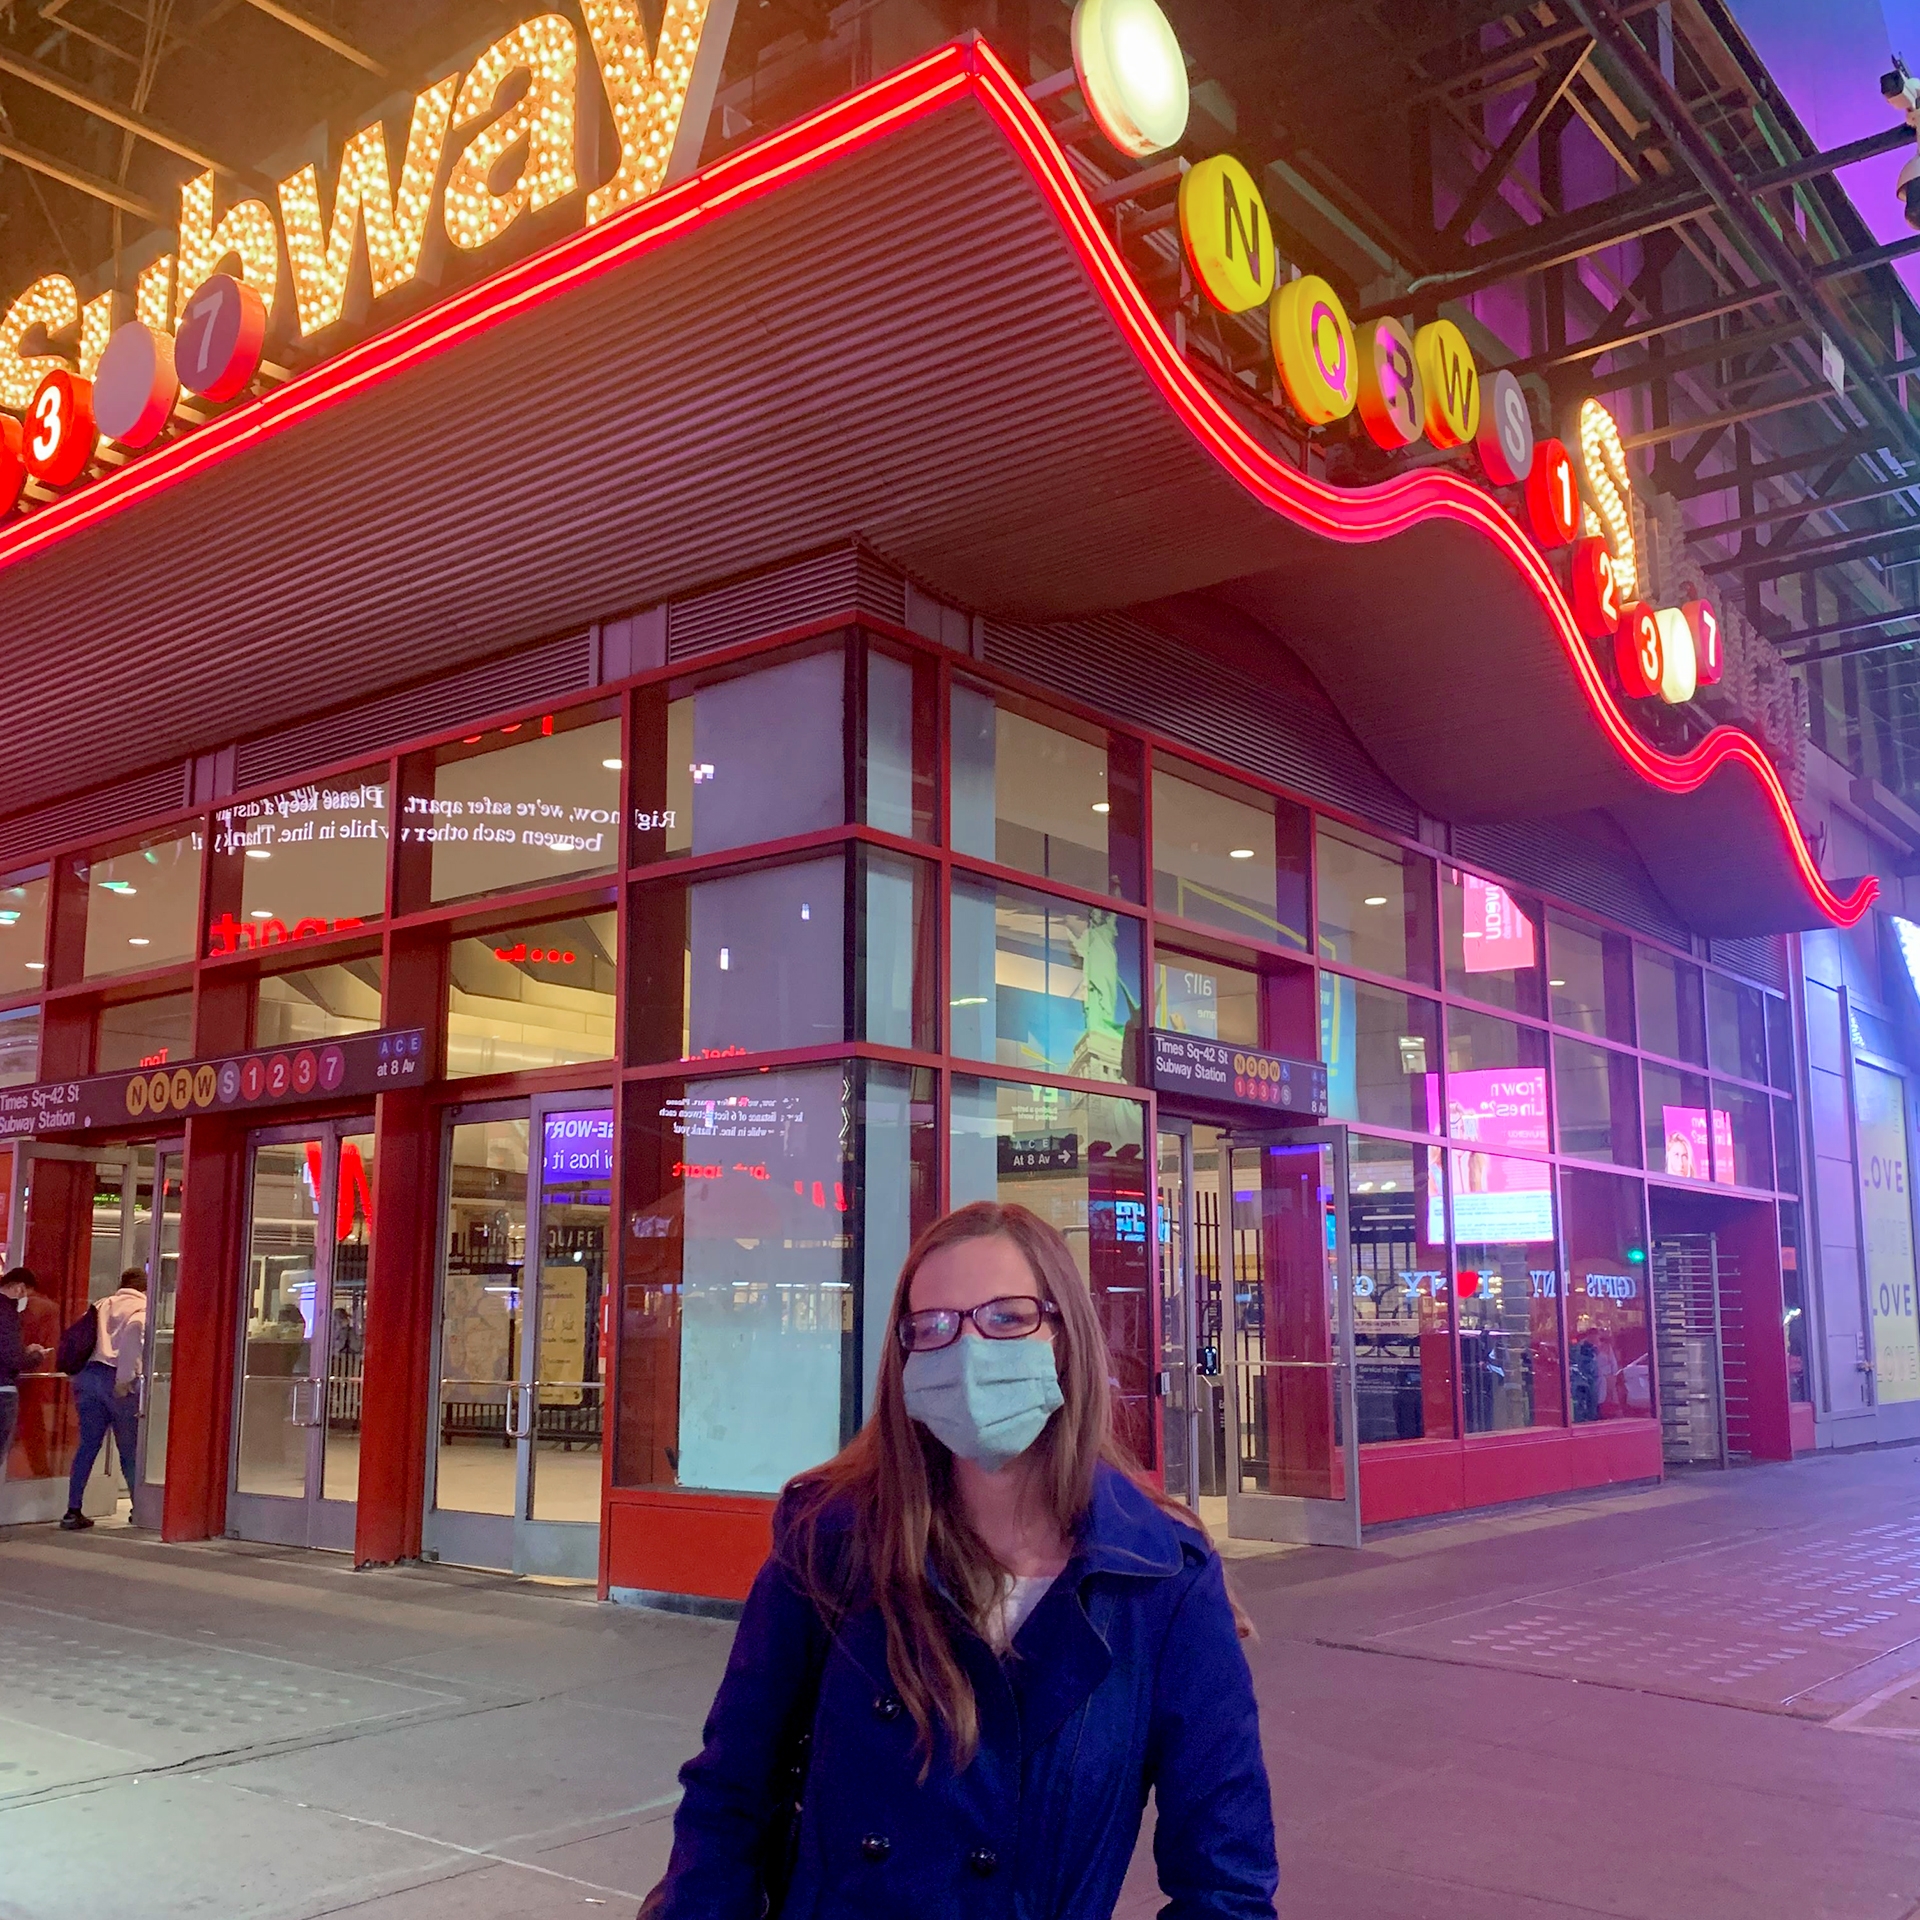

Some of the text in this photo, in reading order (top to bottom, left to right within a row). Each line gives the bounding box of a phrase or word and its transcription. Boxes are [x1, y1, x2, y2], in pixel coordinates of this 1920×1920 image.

[33, 291, 223, 461] 3 7
[1222, 171, 1717, 681] N Q R W S 1 2 3 7
[1156, 1037, 1184, 1056] Times
[1187, 1043, 1216, 1062] Sq-42
[1217, 1052, 1229, 1065] St
[377, 1059, 416, 1077] at 8 Av
[1156, 1056, 1192, 1079] Subway
[1195, 1064, 1227, 1083] Station
[0, 1094, 28, 1111] Times
[31, 1086, 65, 1109] Sq-42
[67, 1084, 80, 1103] St
[131, 1085, 142, 1108] N
[153, 1081, 165, 1108] Q
[176, 1078, 187, 1102] R
[198, 1075, 212, 1098] W
[222, 1070, 234, 1093] S
[273, 1064, 283, 1088] 2
[300, 1058, 310, 1083] 3
[327, 1057, 338, 1081] 7
[1319, 1089, 1327, 1100] at
[1311, 1101, 1327, 1114] 8 Av
[0, 1109, 75, 1133] Subway Station
[1013, 1153, 1050, 1166] At 8 Av
[1359, 1366, 1382, 1374] Service
